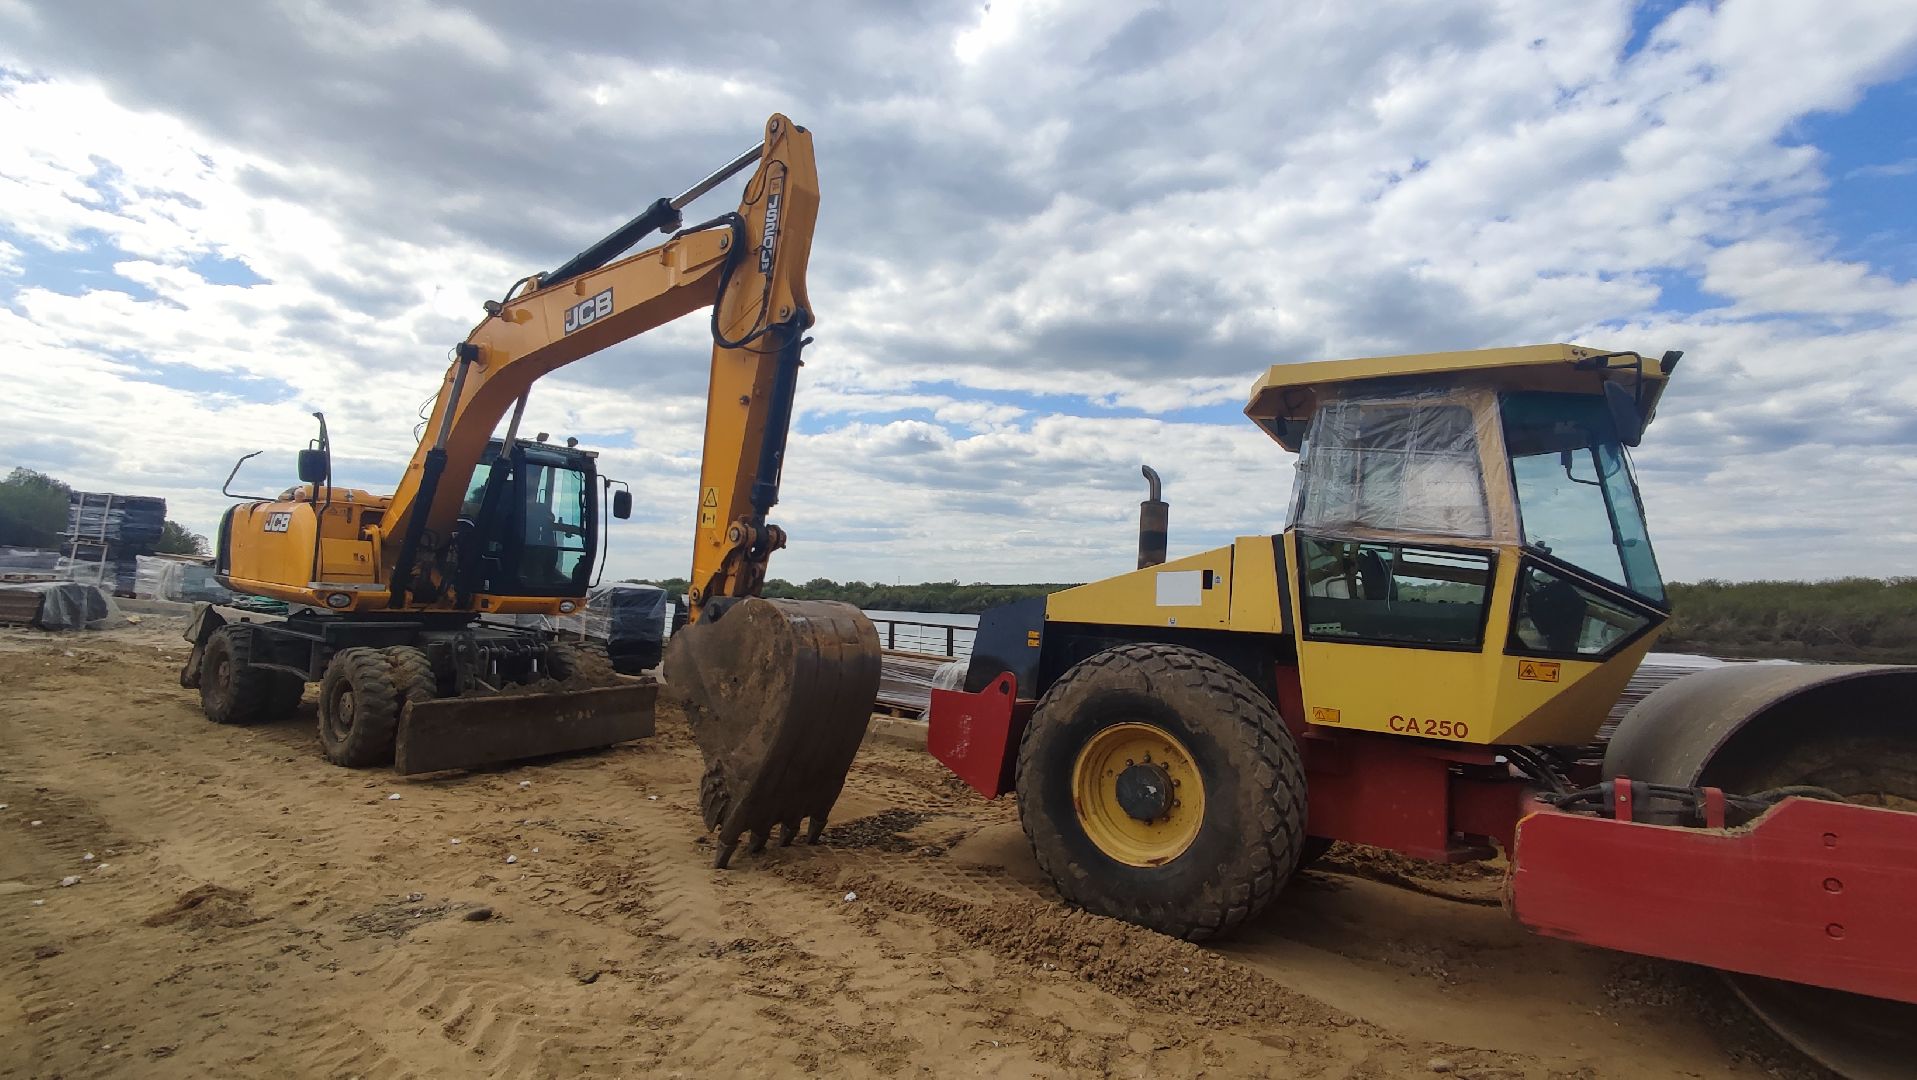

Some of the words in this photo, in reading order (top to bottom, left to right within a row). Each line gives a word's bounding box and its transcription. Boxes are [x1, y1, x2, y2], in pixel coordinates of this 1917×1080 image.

[565, 291, 613, 332] JCB
[264, 513, 291, 532] JCB
[1389, 715, 1420, 733] CA
[1424, 719, 1468, 738] 250
